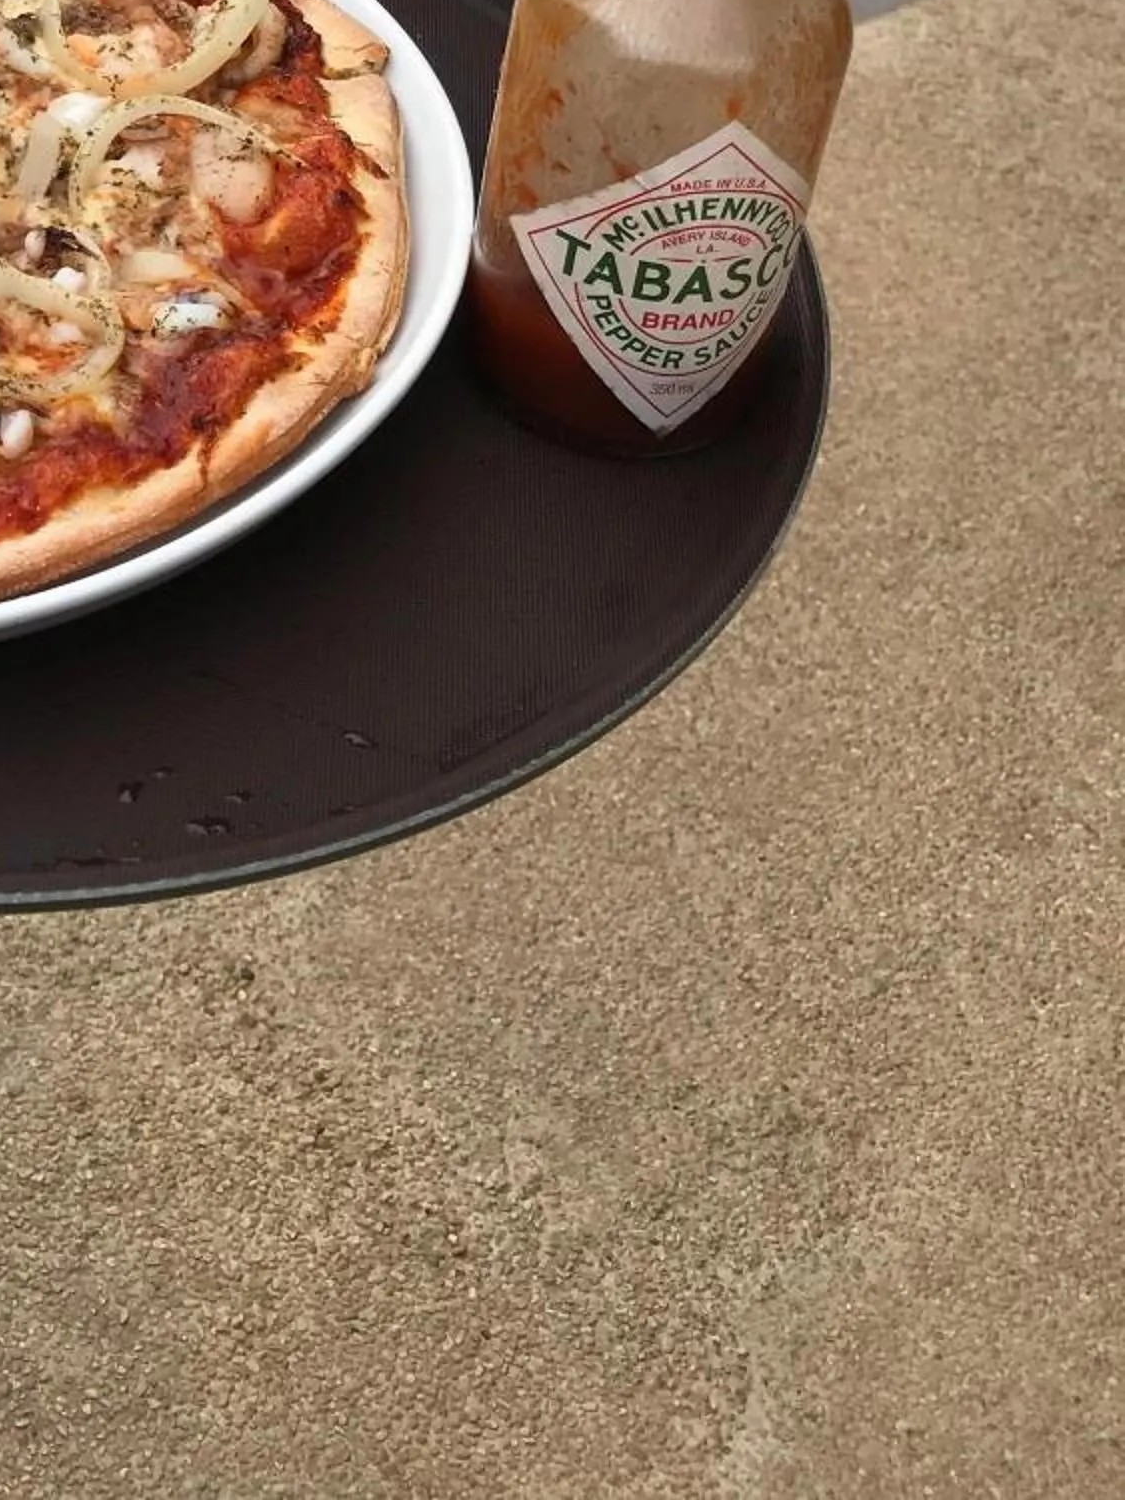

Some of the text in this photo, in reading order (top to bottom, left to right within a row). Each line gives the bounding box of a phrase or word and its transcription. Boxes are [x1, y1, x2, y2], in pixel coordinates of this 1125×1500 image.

[670, 180, 712, 193] MADE
[716, 178, 732, 189] IN
[662, 230, 753, 250] AVERY ISLAND
[586, 290, 771, 369] PEPPER SAUCE
[641, 308, 735, 331] BRAND
